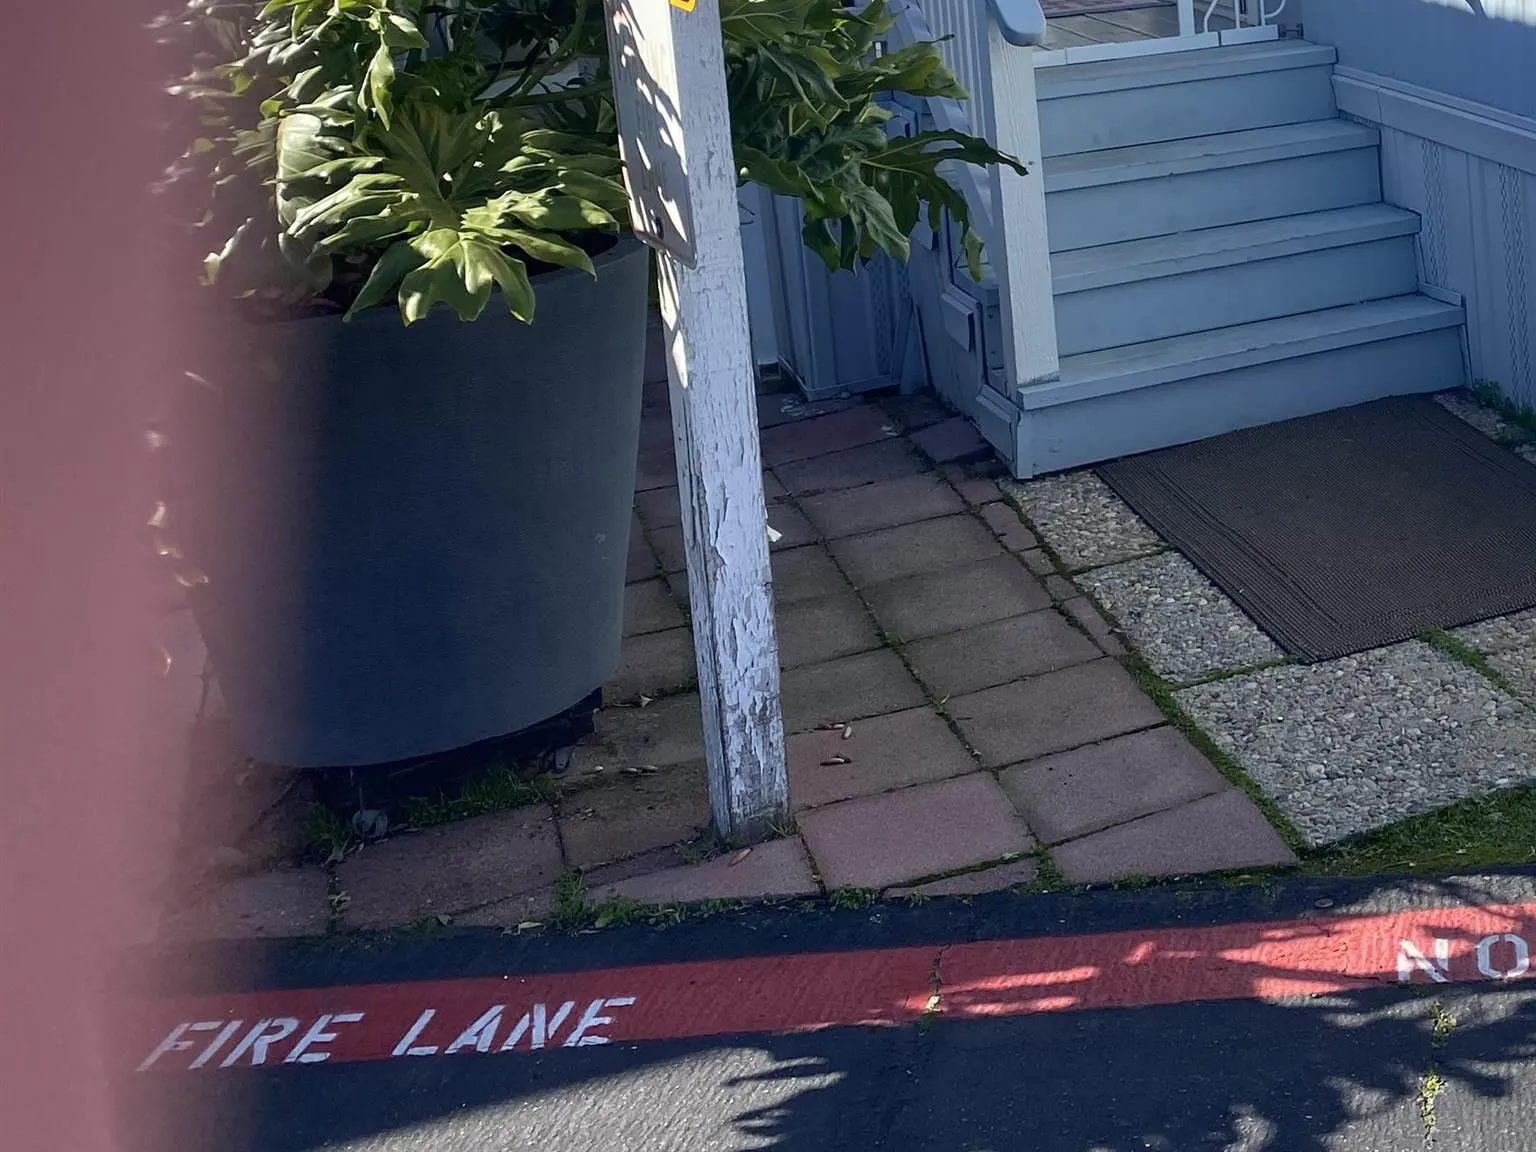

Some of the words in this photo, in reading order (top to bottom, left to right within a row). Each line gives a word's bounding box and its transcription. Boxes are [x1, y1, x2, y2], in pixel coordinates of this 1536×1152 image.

[1397, 933, 1530, 984] NO
[136, 1012, 365, 1072] FIRE
[391, 996, 636, 1057] LANE
